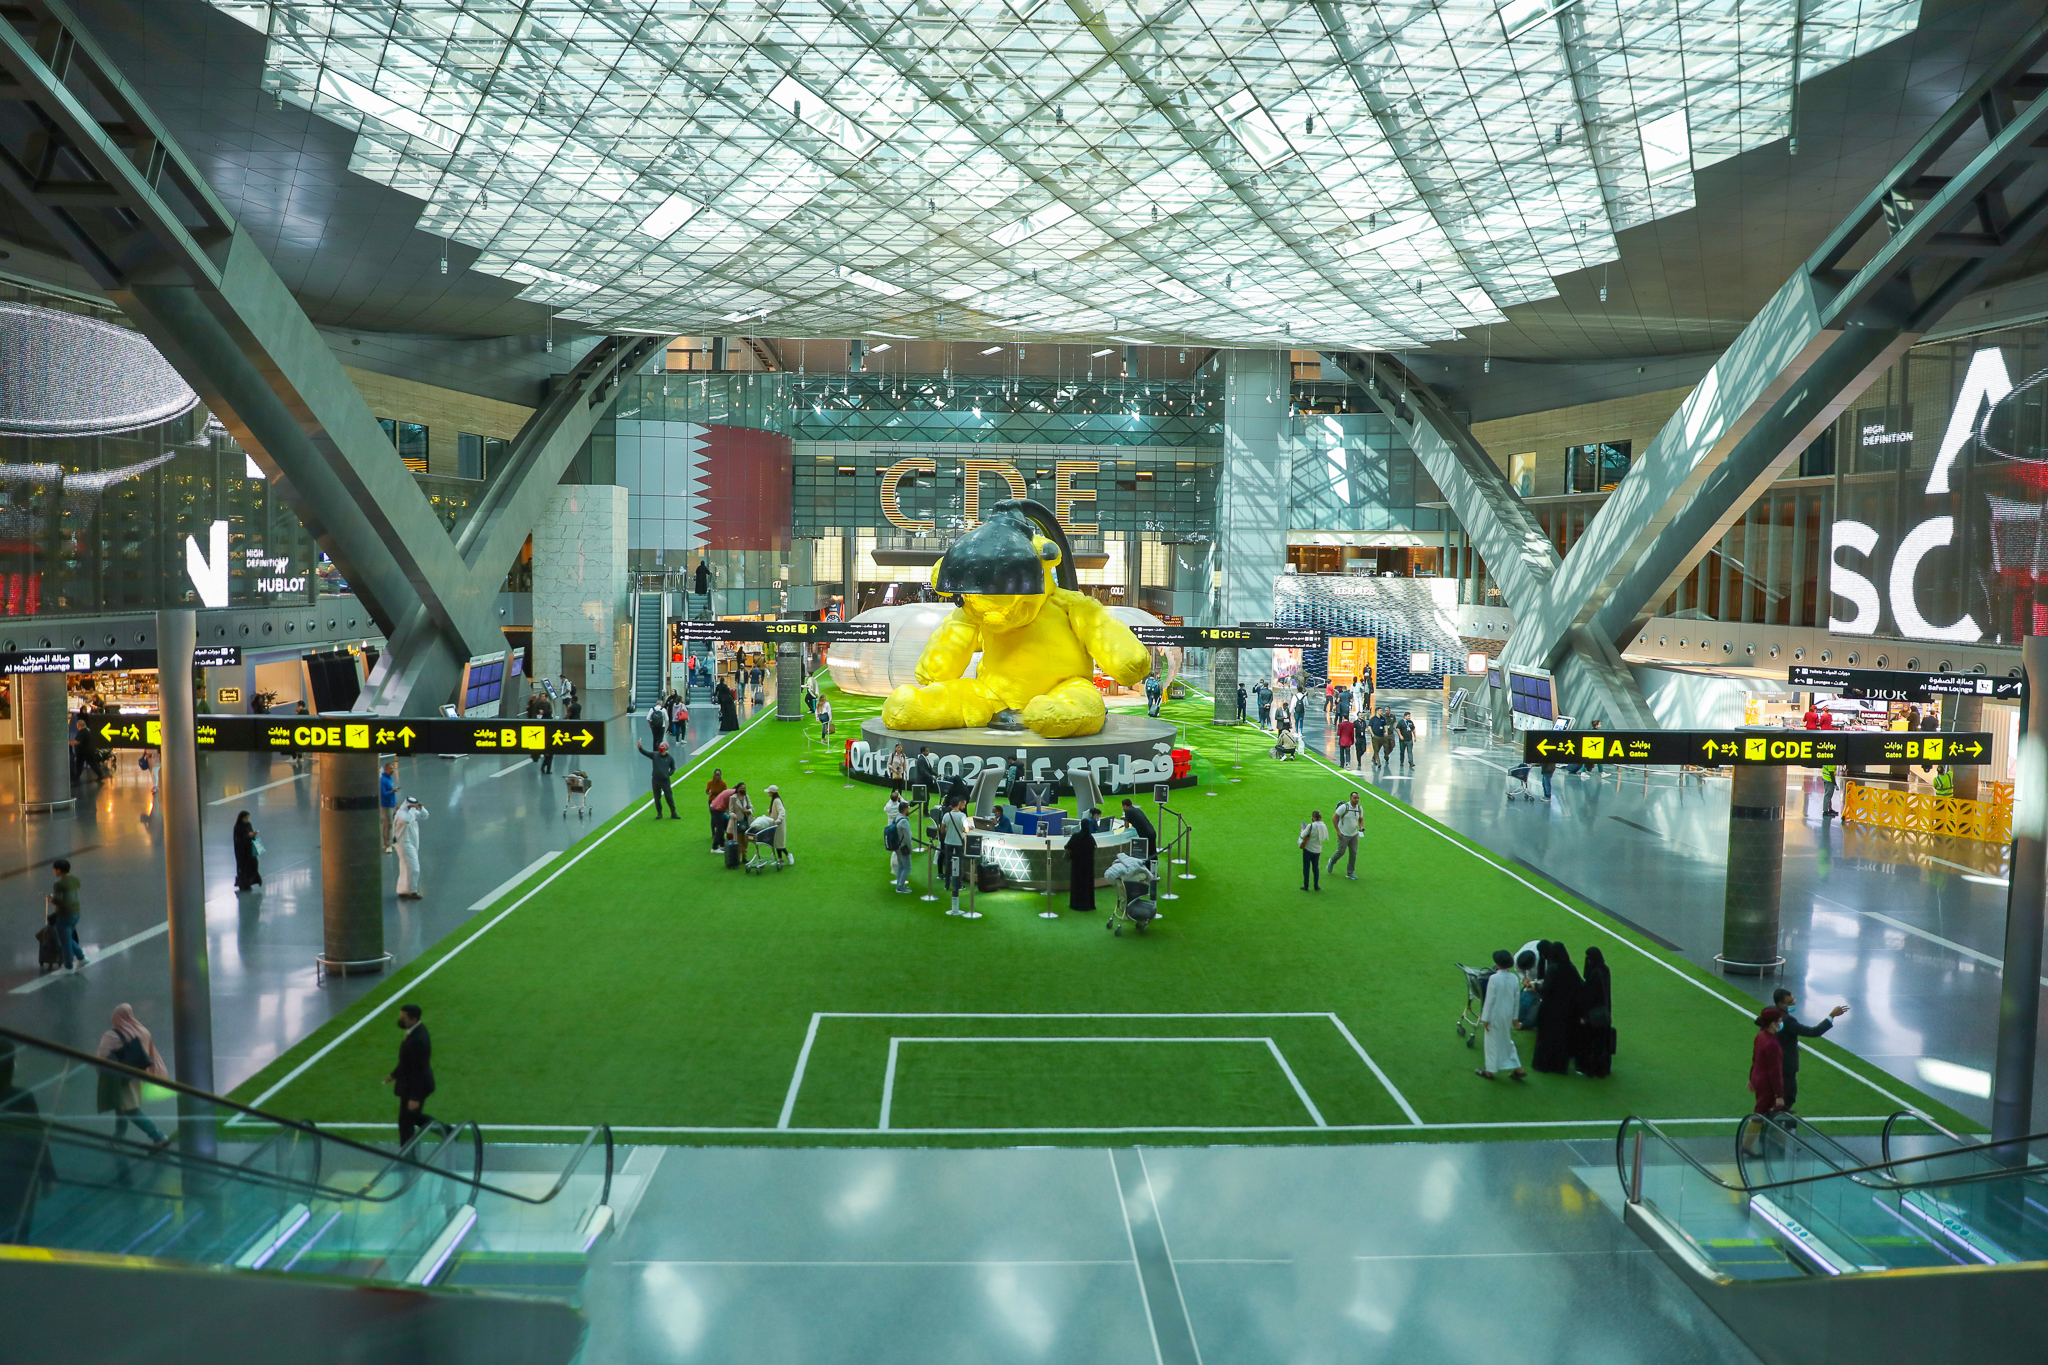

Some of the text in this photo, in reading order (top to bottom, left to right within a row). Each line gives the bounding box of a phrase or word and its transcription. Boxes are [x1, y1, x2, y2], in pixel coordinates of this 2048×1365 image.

[1863, 424, 1885, 436] HIGH
[1863, 431, 1913, 446] DEFINITION
[880, 457, 1100, 535] CDE
[246, 549, 264, 558] HIGH
[257, 577, 306, 593] HUBLOT
[776, 624, 797, 634] CDE
[1220, 630, 1241, 639] CDE
[4, 663, 71, 674] Al Mourjan Lounge
[1919, 684, 1927, 692] Al
[1928, 685, 1948, 693] Safwa
[1865, 689, 1908, 701] DIOR
[270, 737, 290, 746] Gates
[294, 726, 341, 746] CDE
[501, 729, 517, 747] B
[476, 739, 497, 748] Gates
[1609, 739, 1625, 758] A
[1629, 750, 1649, 758] Gates
[1770, 741, 1813, 759] CDE
[1816, 751, 1834, 759] Gates
[1885, 751, 1902, 759] Gates
[1907, 741, 1920, 758] B
